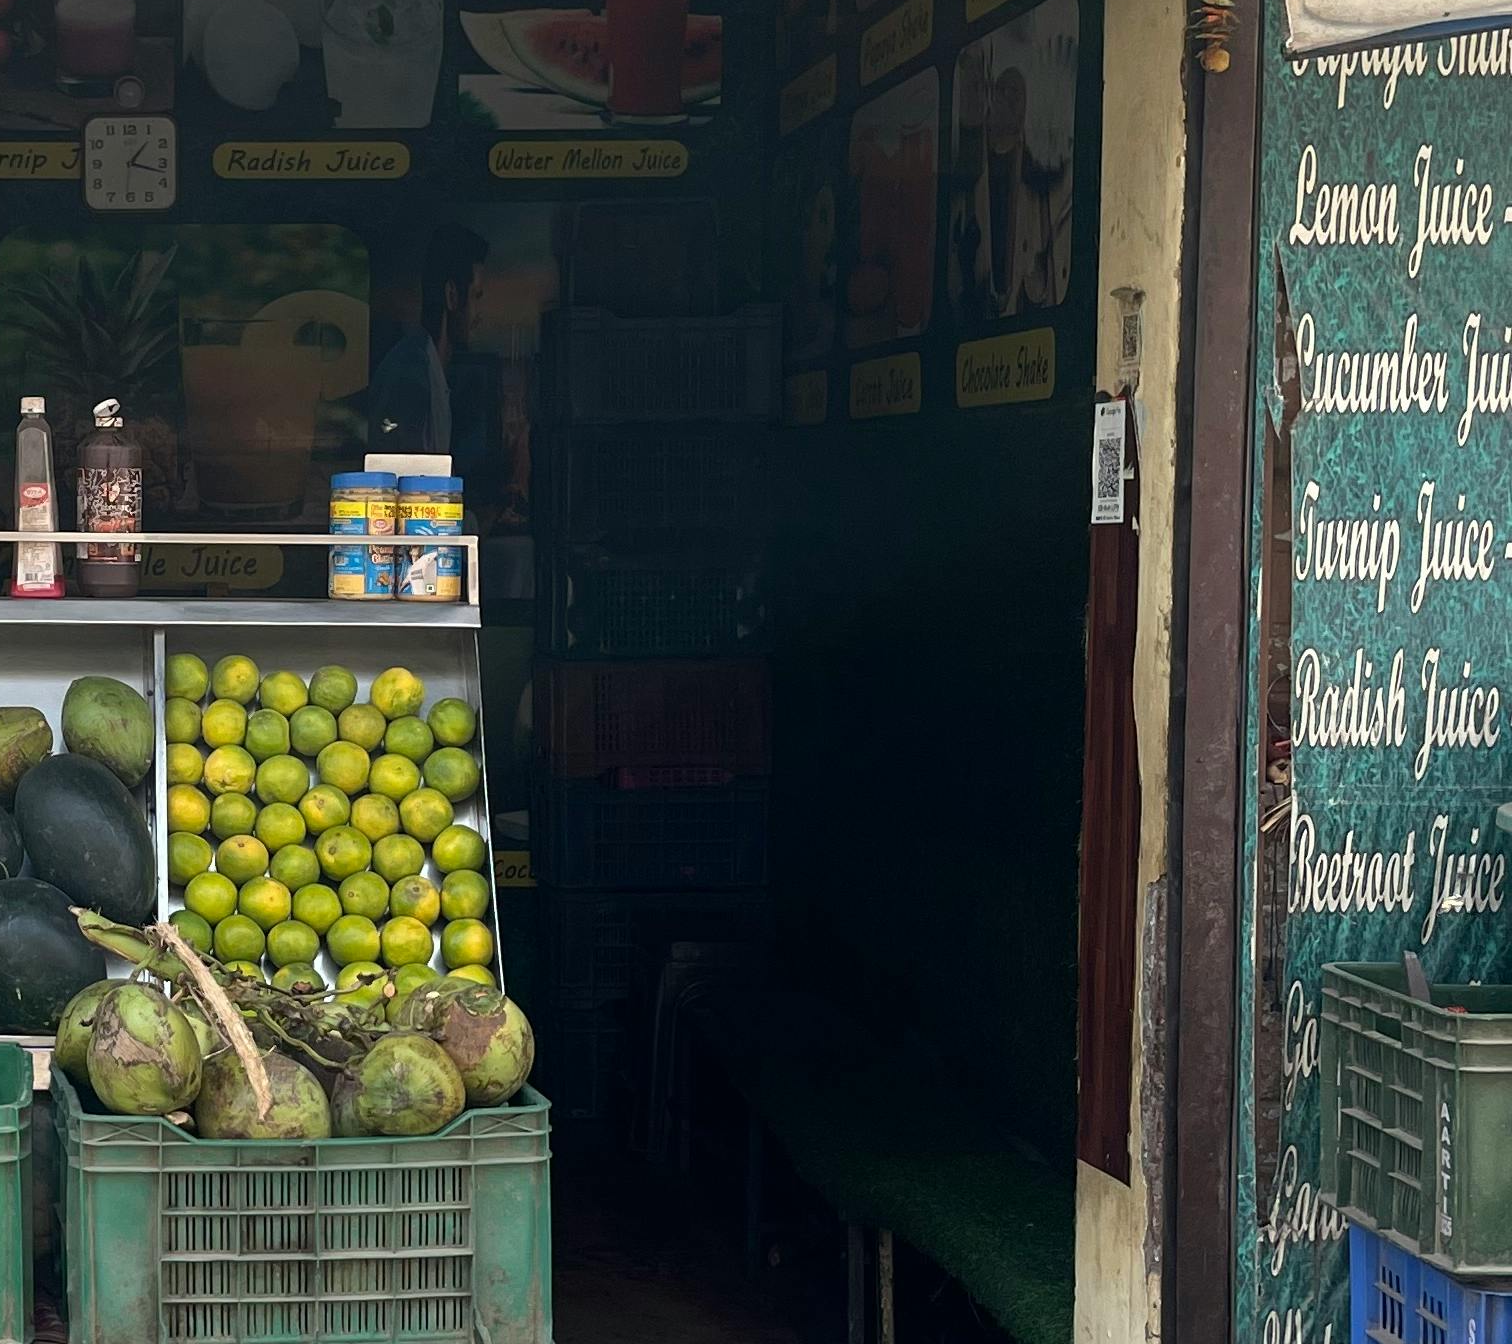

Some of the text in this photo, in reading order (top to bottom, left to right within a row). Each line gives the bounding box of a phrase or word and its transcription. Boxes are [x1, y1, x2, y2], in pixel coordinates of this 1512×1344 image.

[89, 138, 168, 150] 10 2
[122, 124, 137, 136] 12
[92, 157, 168, 170] 9 3
[226, 148, 396, 173] Radish Juice
[493, 147, 683, 173] Water Mellon Juice
[93, 177, 168, 189] 8 4
[106, 191, 116, 203] 7
[125, 191, 136, 203] 6
[1289, 144, 1400, 246] Lemon
[1408, 144, 1493, 279] Juice
[961, 346, 1050, 394] Chocolate Shake
[1297, 313, 1512, 446] Cucumber Jui
[1296, 479, 1400, 613] Turnip
[1411, 479, 1494, 613] Juice
[180, 546, 258, 578] Juice
[1292, 648, 1500, 781] Radish Juice
[1289, 811, 1505, 945] Beetroot Juice
